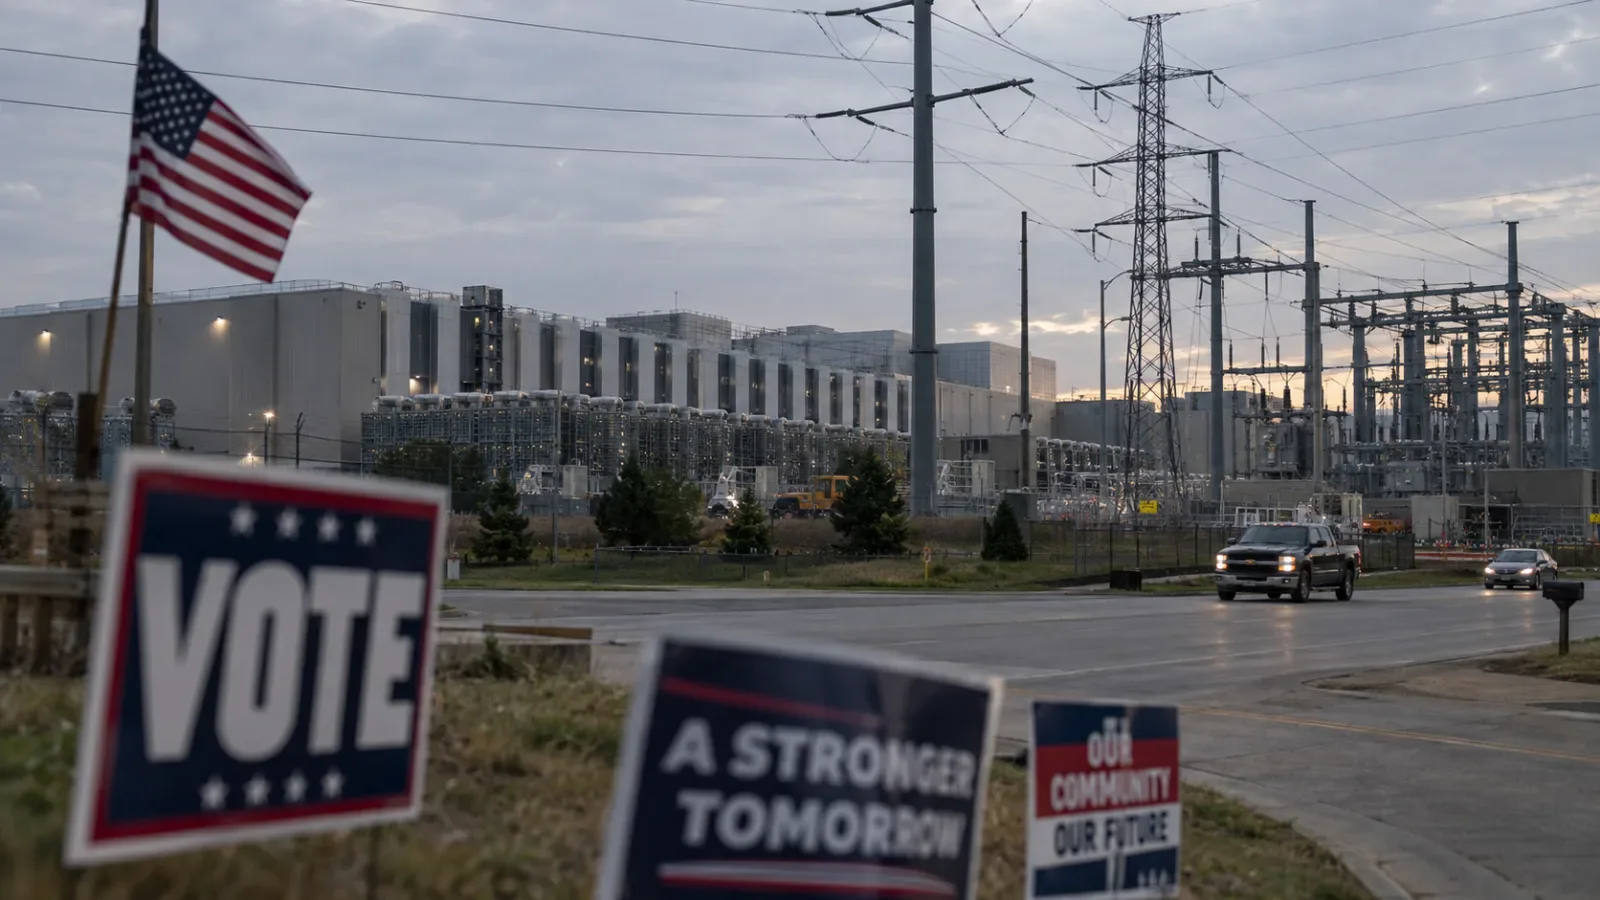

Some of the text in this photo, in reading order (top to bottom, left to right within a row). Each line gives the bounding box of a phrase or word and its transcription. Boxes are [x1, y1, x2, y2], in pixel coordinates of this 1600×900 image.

[137, 554, 426, 763] VOTE
[661, 717, 976, 798] A STRONGER
[1087, 731, 1133, 768] OUR
[1050, 767, 1171, 811] COMMUNITY
[676, 789, 967, 859] TOMORROW
[1054, 809, 1169, 858] OUR FUTURE
